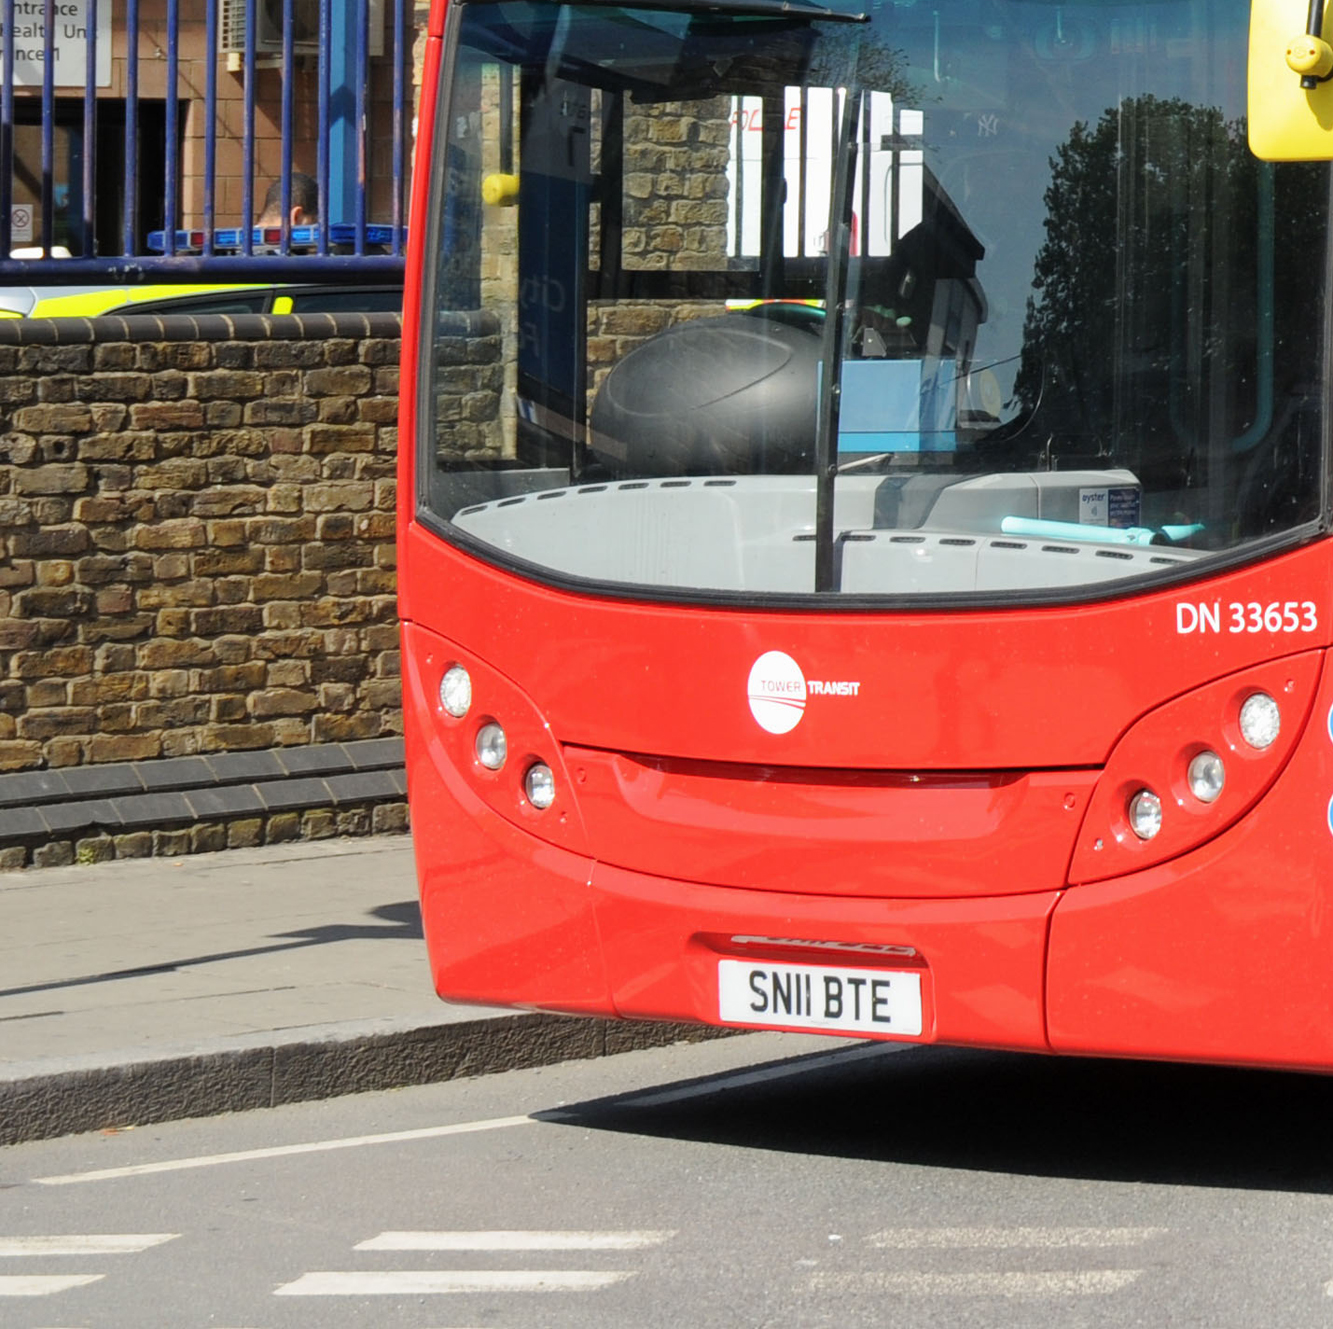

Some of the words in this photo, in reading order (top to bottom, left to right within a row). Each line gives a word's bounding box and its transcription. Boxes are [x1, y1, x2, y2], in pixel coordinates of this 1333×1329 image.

[1176, 602, 1220, 634] DN
[1228, 601, 1318, 633] 33653
[761, 680, 801, 692] TOWER
[807, 680, 860, 696] TRANSIT
[749, 970, 811, 1016] SN11
[823, 975, 891, 1023] BTE
